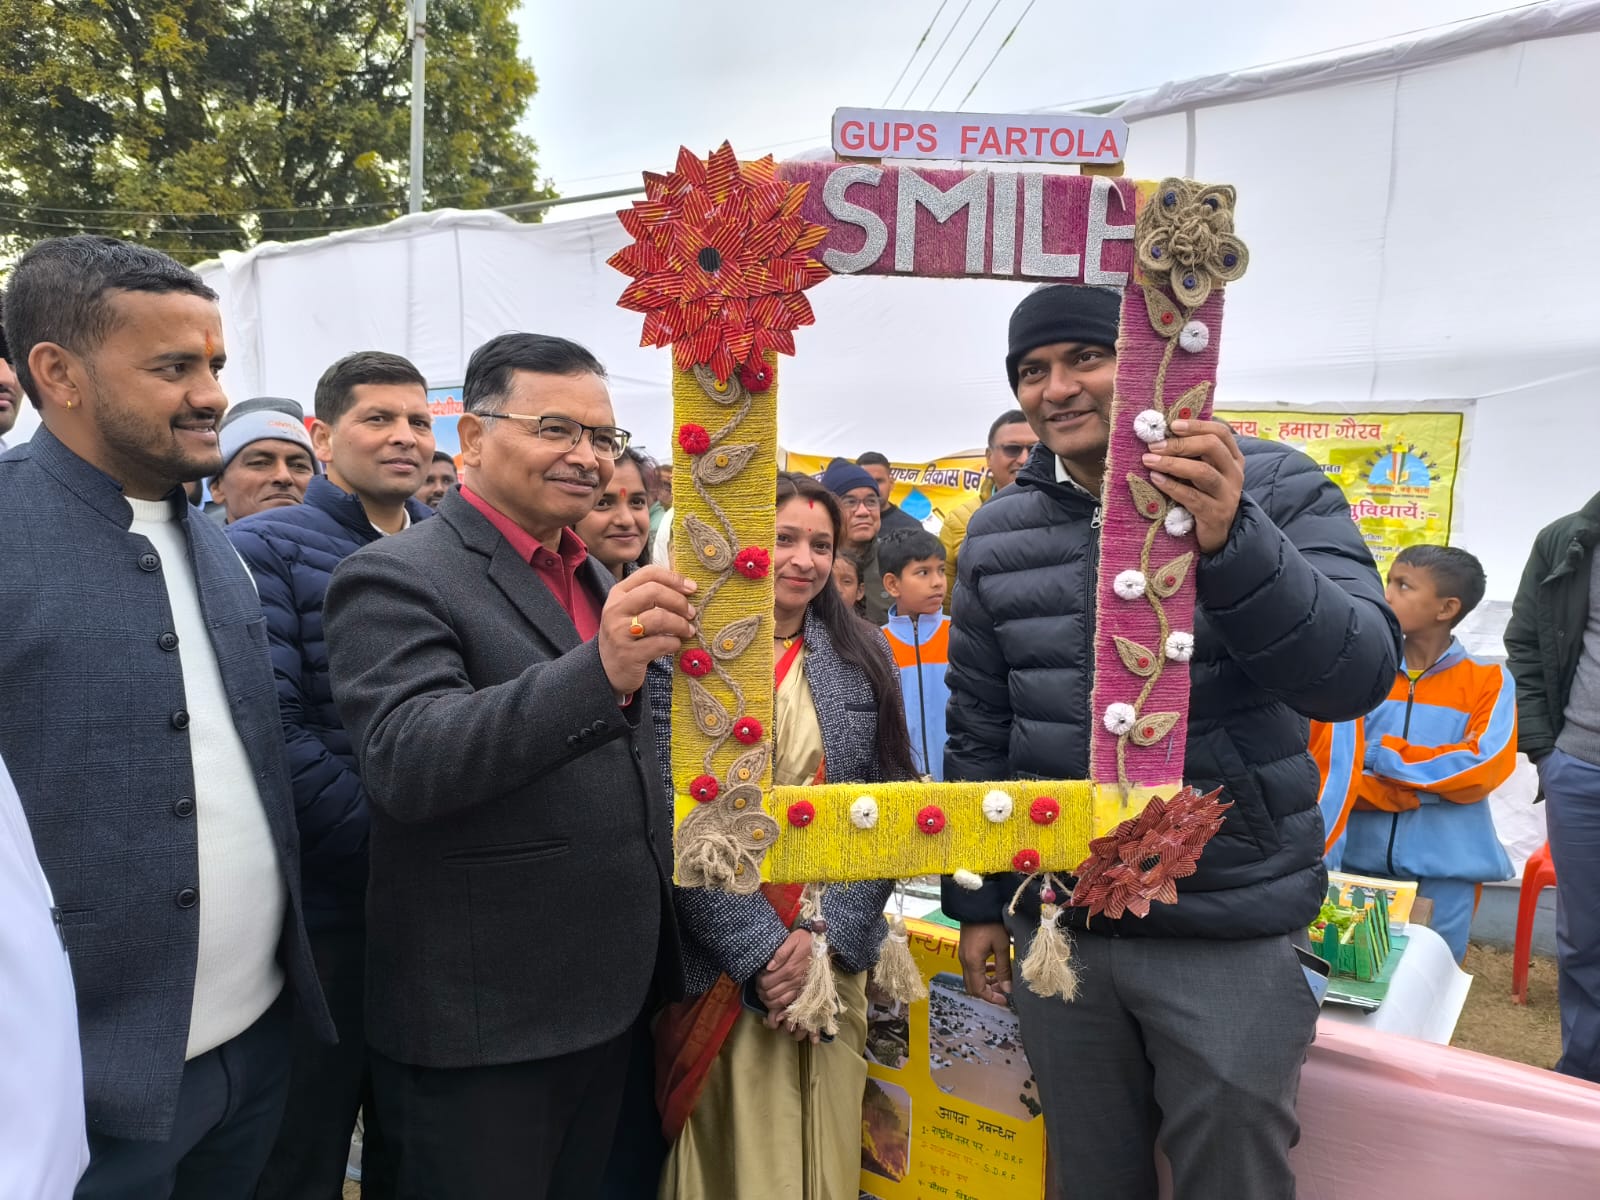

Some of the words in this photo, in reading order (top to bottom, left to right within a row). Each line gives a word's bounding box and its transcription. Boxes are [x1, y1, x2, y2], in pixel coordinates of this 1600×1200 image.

[840, 120, 938, 153] GUPS
[960, 125, 1120, 158] FARTOLA
[822, 164, 1136, 287] SMILE
[1278, 421, 1330, 440] हमारा
[1335, 416, 1382, 440] गौरव
[922, 463, 960, 487] विकास
